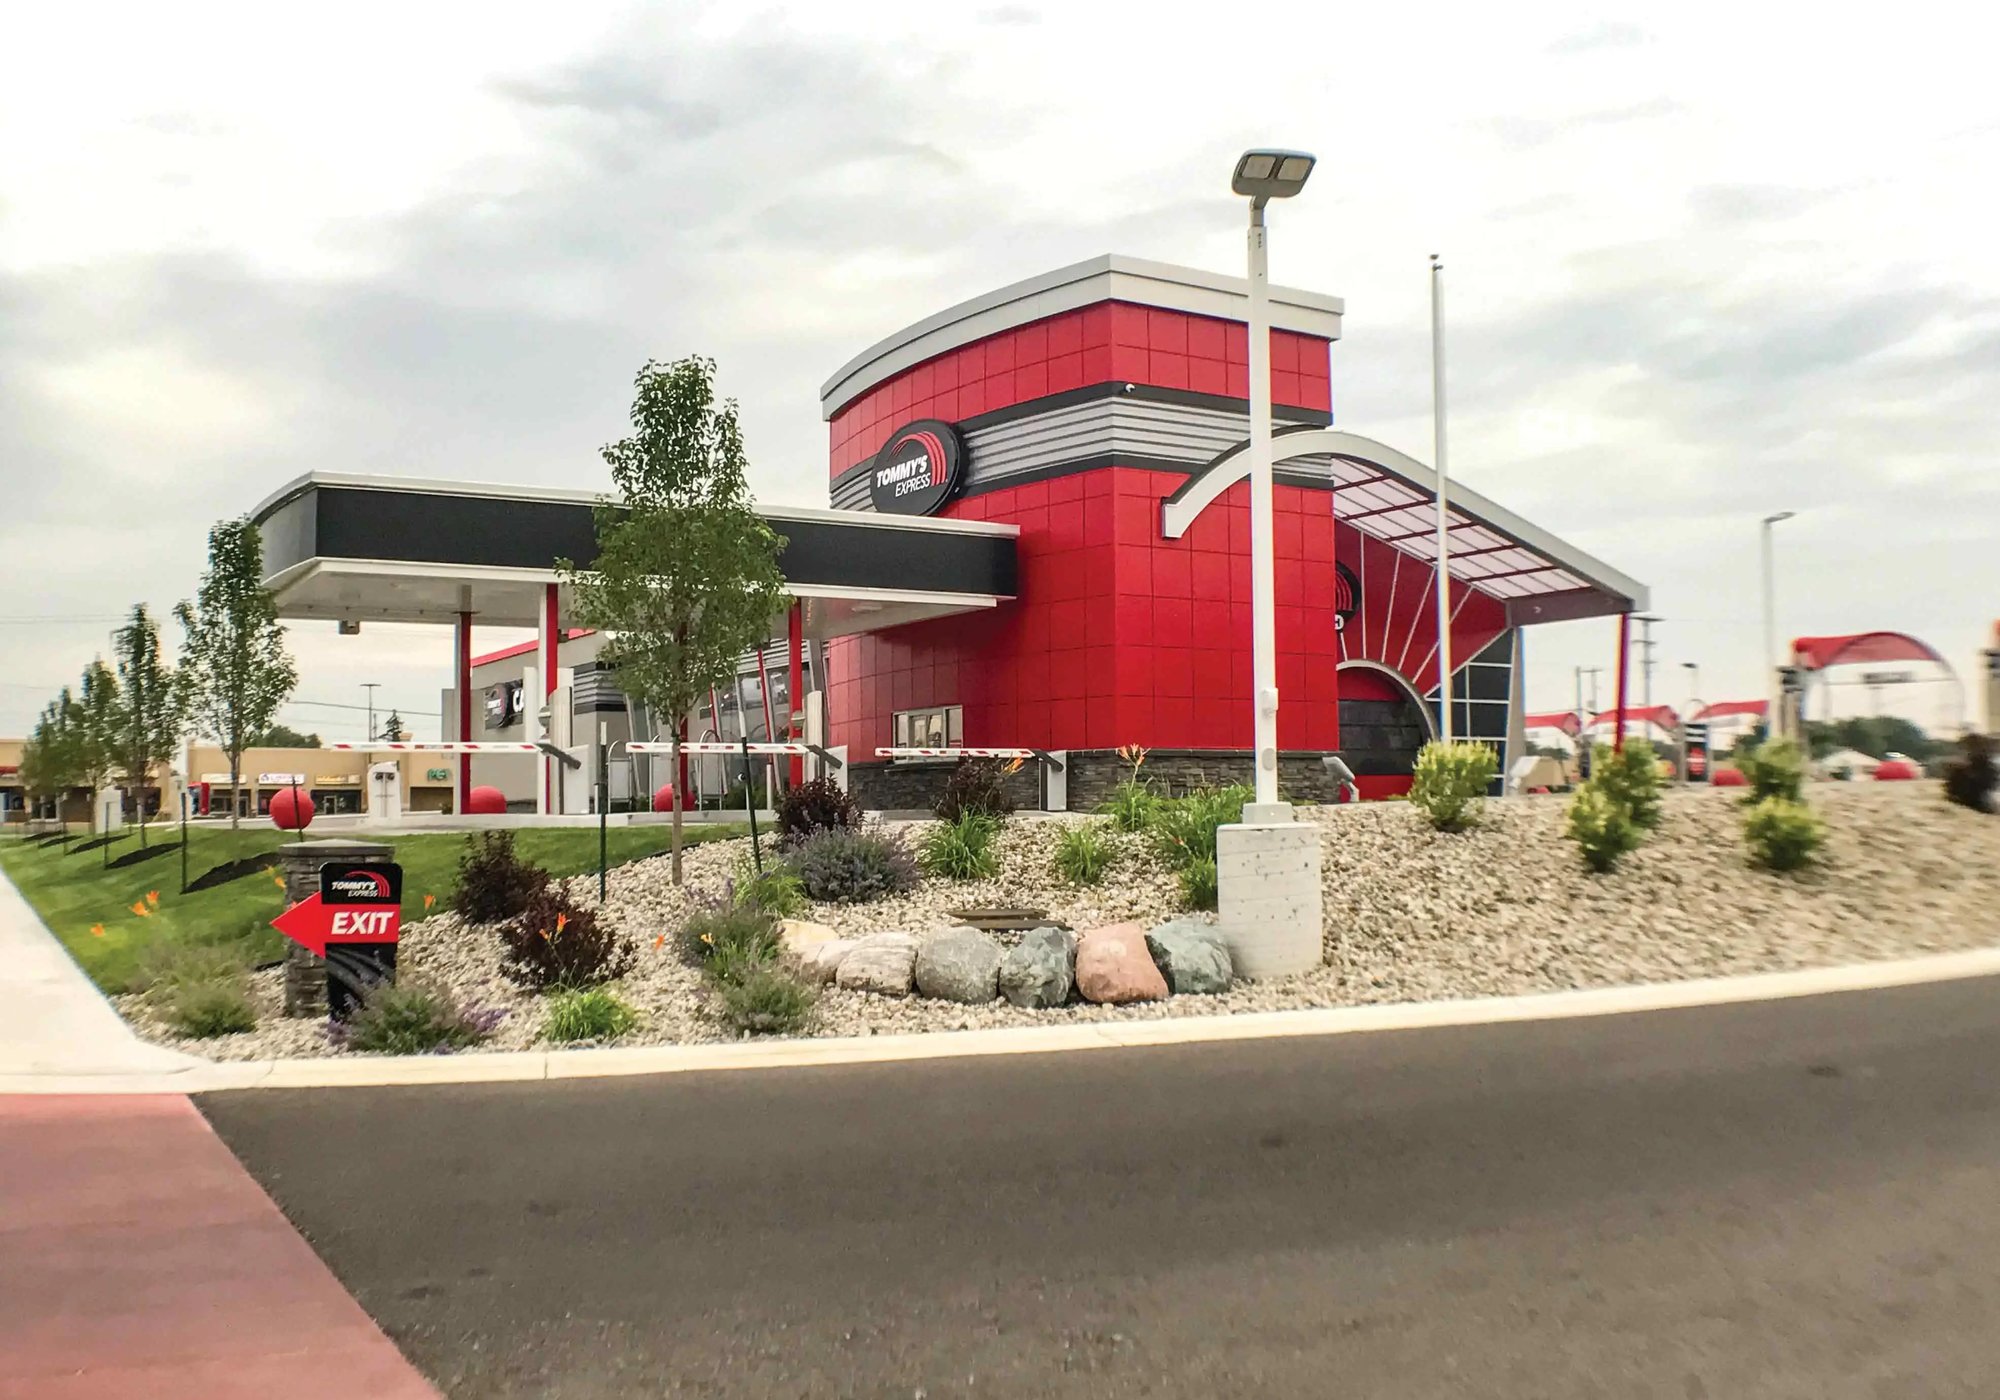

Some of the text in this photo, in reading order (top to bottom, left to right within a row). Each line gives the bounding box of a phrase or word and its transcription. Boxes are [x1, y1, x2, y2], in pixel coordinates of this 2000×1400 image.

[876, 454, 928, 488] TOMMY'S
[895, 472, 931, 498] EXPRESS
[332, 881, 376, 890] TOMMY'S
[331, 912, 395, 935] EXIT
